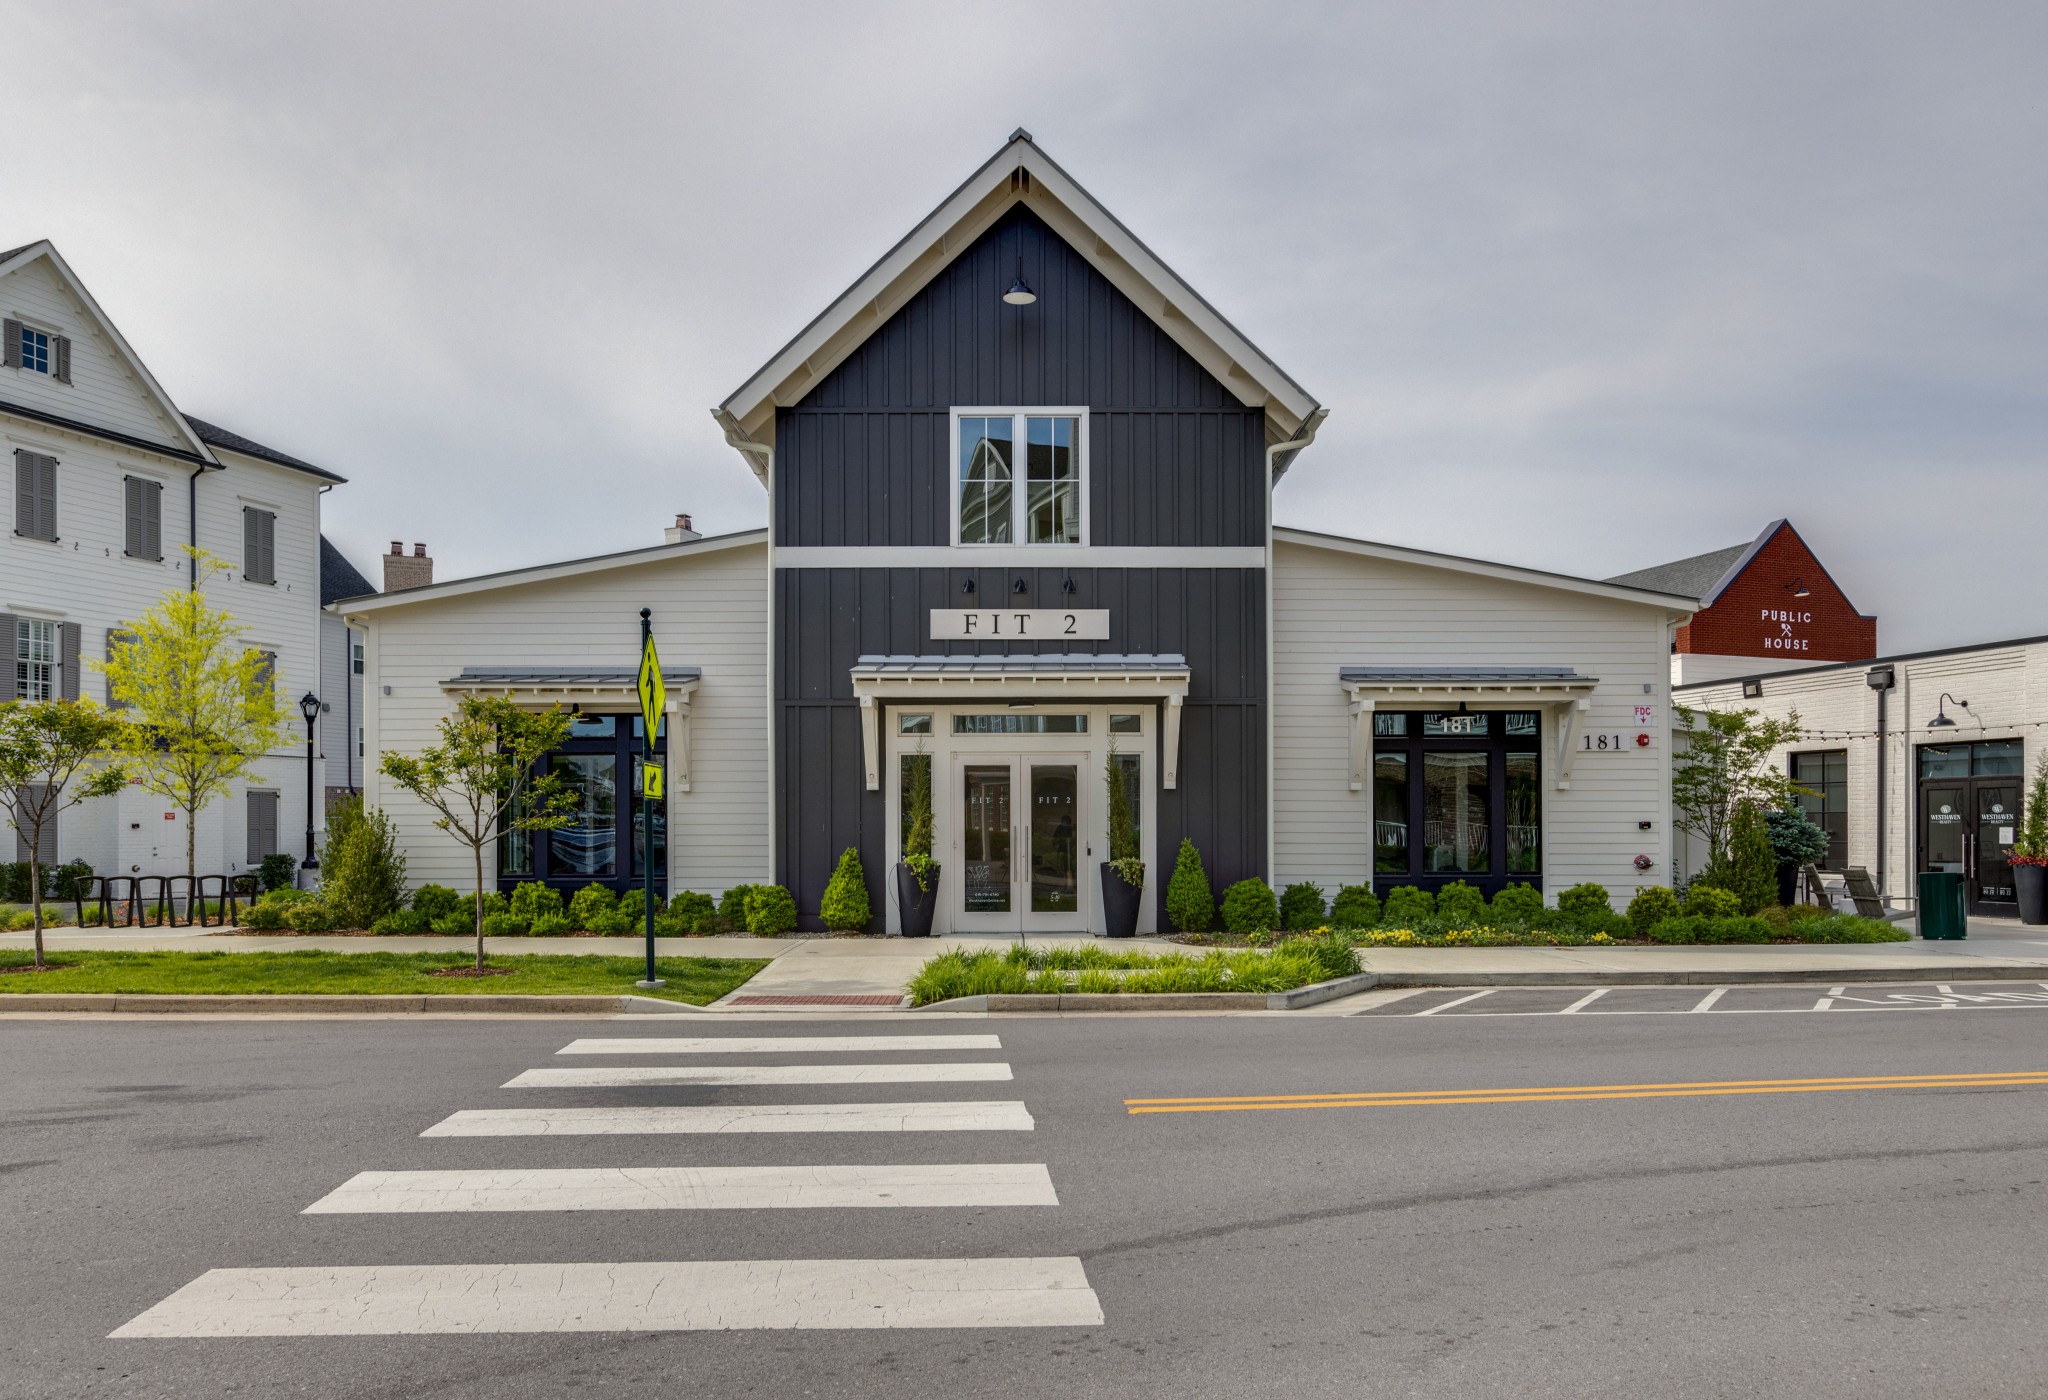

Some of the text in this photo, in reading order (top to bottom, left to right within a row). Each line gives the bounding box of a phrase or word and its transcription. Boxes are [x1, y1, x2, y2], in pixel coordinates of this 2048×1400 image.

[1761, 609, 1811, 623] PUBLIC
[963, 614, 1077, 635] FIT 2
[1764, 637, 1809, 650] HOUSE
[1634, 707, 1651, 716] FDC
[1440, 717, 1471, 733] 181
[1583, 734, 1621, 750] 181
[971, 796, 991, 804] FIT
[1038, 796, 1071, 804] FIT 2
[1830, 991, 2048, 1005] LOAD
